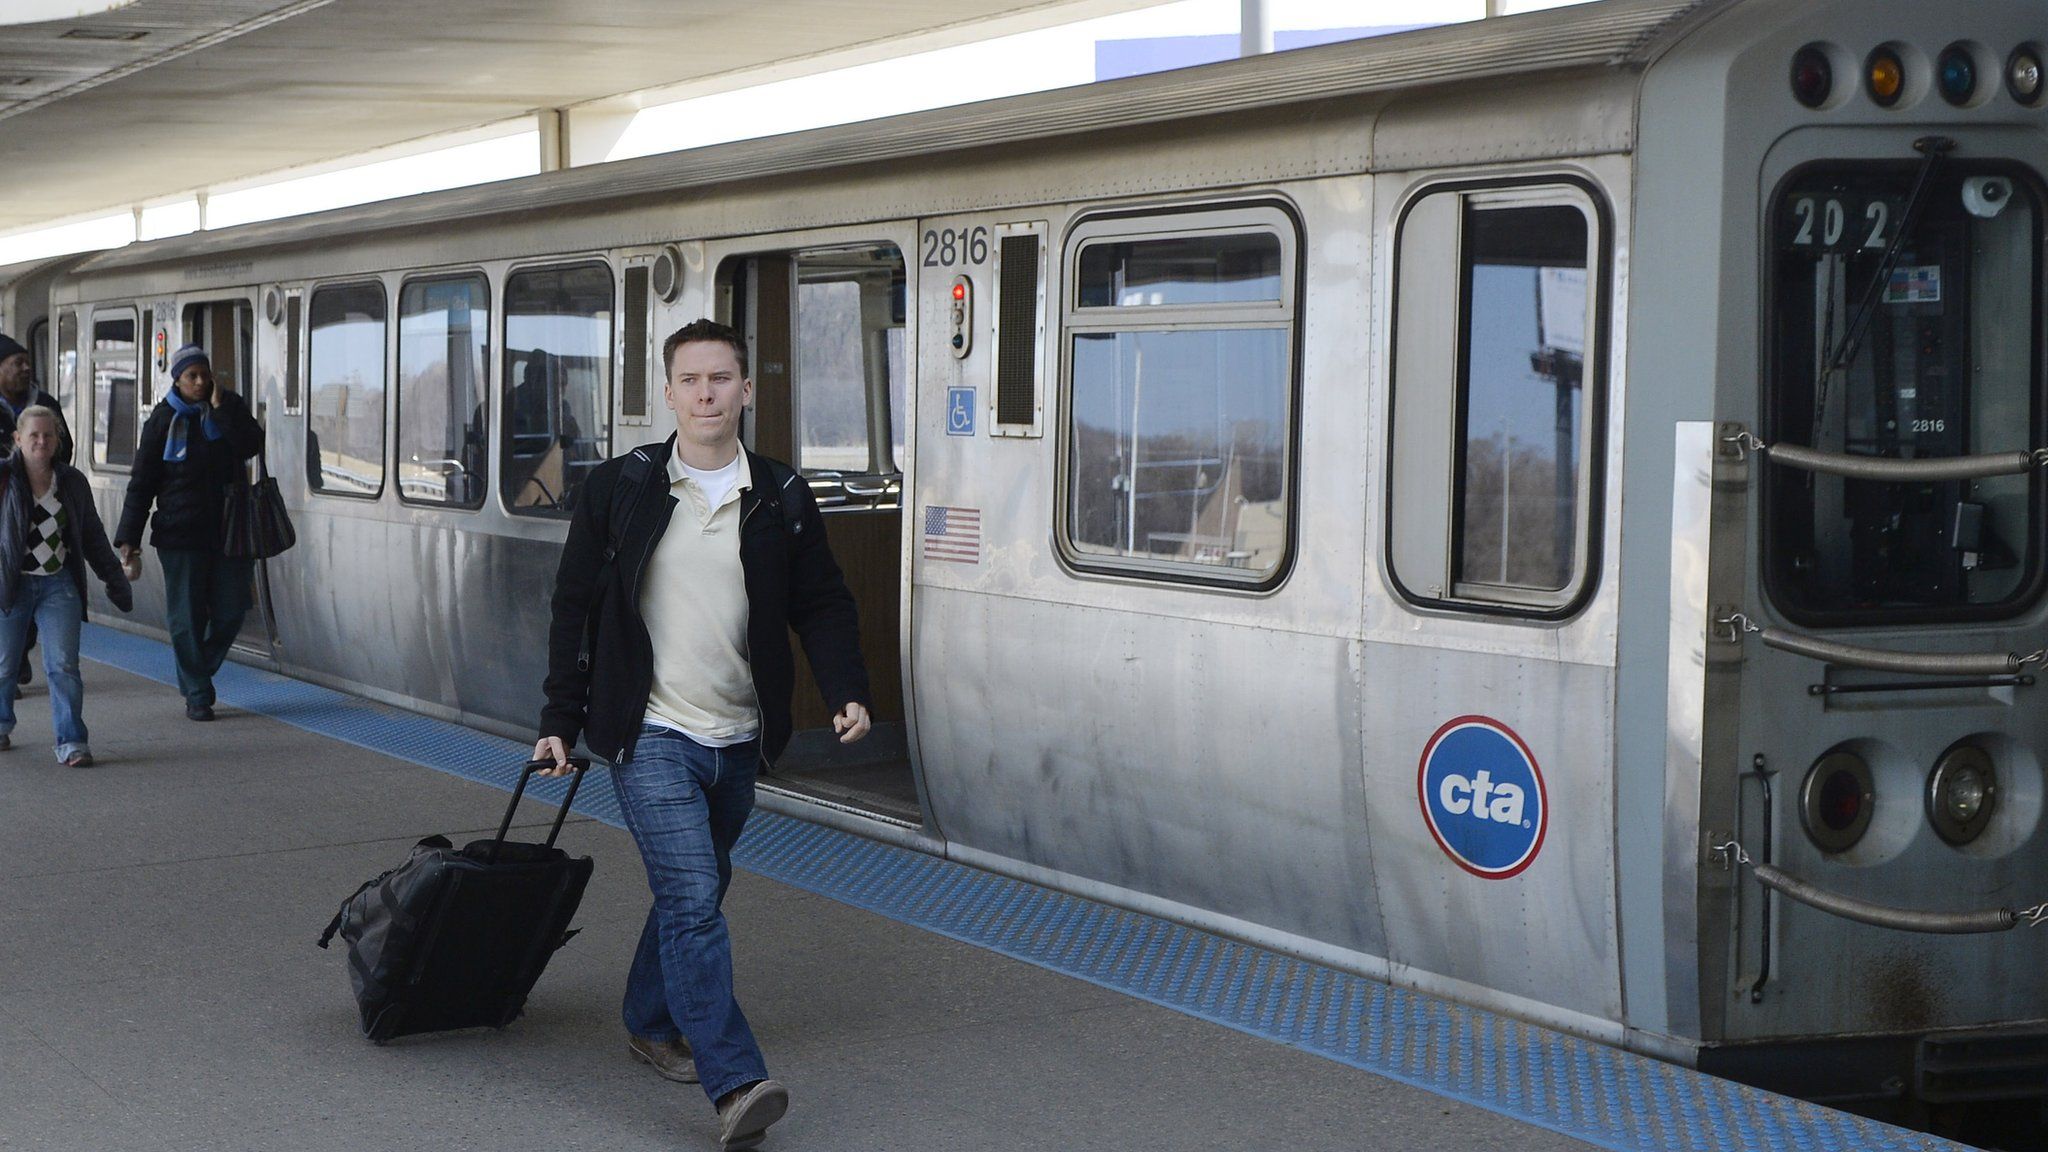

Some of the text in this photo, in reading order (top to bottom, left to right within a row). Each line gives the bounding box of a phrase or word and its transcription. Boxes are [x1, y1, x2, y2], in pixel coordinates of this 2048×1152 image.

[923, 226, 988, 267] 2816
[156, 301, 177, 322] 2816
[1912, 419, 1945, 433] 2816
[1439, 769, 1525, 826] cta
